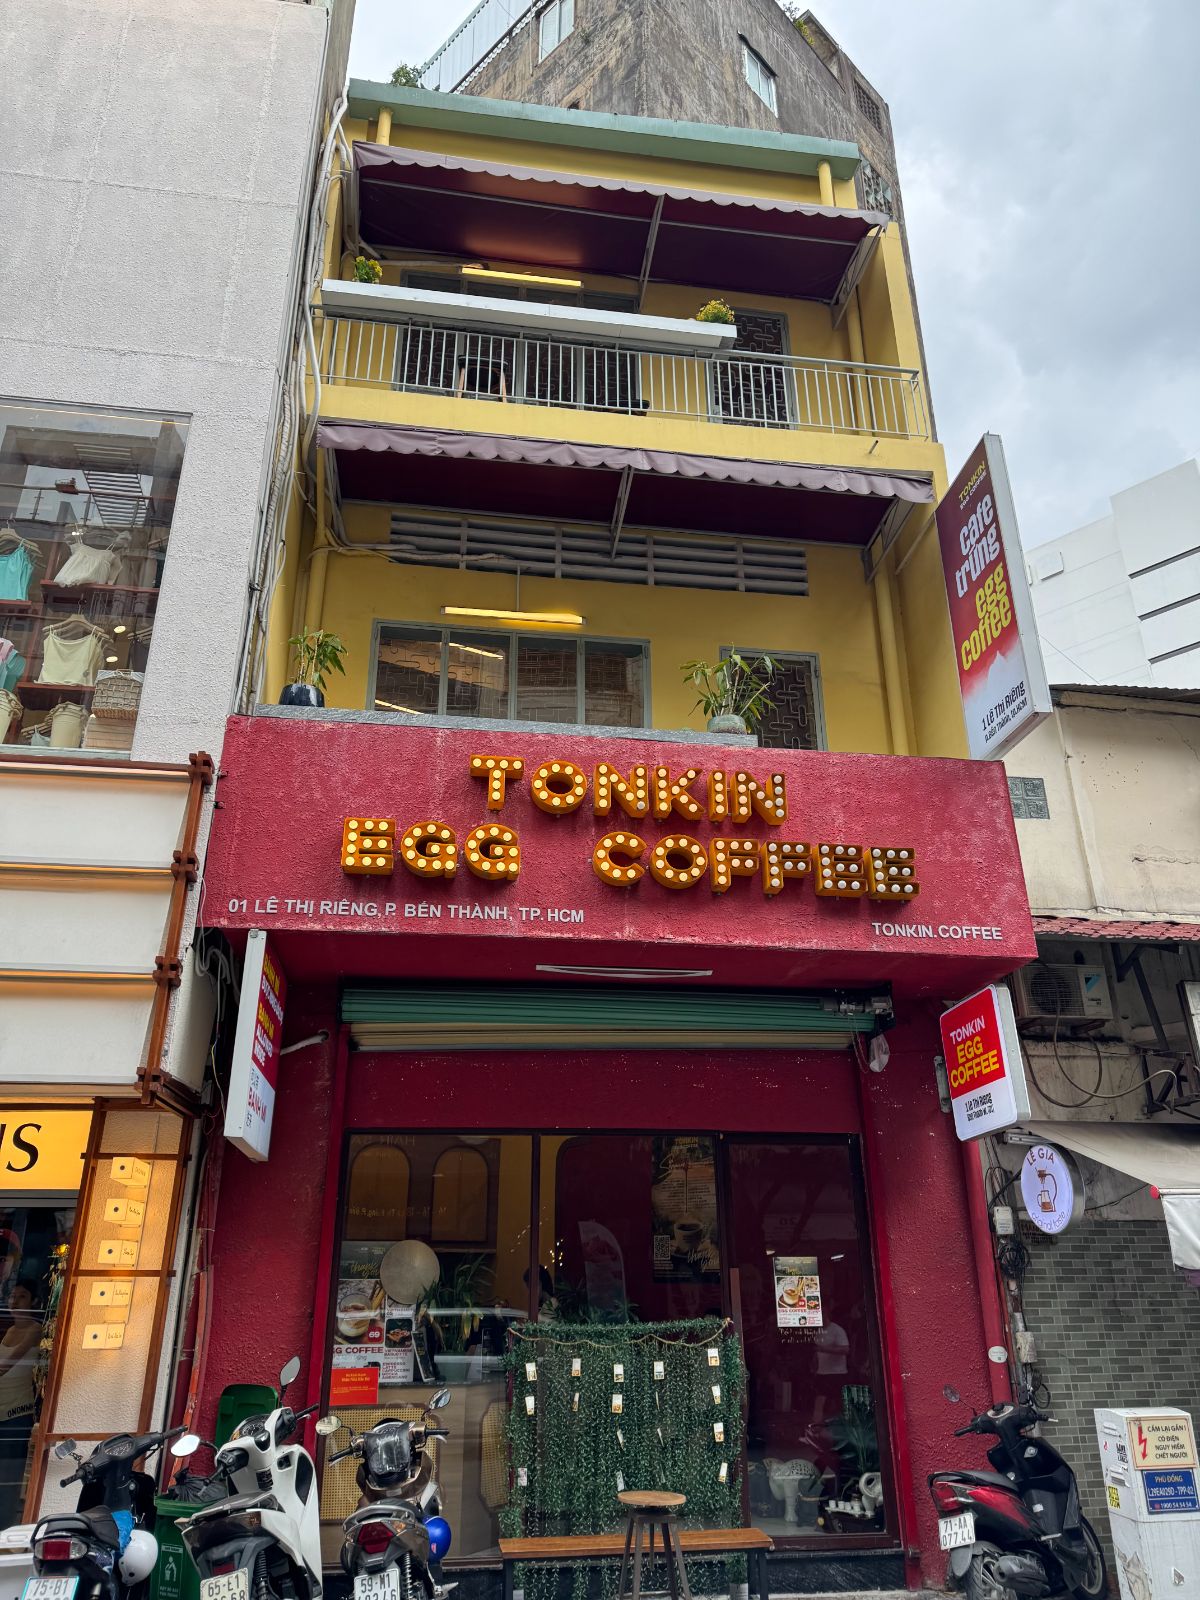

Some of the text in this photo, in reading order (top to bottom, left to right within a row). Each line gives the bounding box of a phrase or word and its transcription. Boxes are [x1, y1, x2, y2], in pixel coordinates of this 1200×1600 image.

[958, 461, 986, 501] TONKIN
[960, 494, 993, 556] cafe
[975, 562, 1007, 619] egg
[961, 595, 1012, 671] coffee
[987, 707, 996, 727] Lê
[995, 695, 1006, 718] Thị
[1004, 679, 1026, 711] Riêng
[470, 754, 788, 825] TONKIN
[341, 817, 921, 900] EGG COFFEE
[228, 899, 247, 913] 01
[254, 896, 279, 914] LÊ
[284, 899, 314, 918] THỊ
[404, 900, 442, 918] BẾN
[448, 902, 513, 922] THÀNH,
[871, 922, 1003, 941] TONKIN.COFFEE
[950, 1015, 986, 1045] TONKIN
[956, 1036, 984, 1064] EGG
[950, 1049, 1000, 1088] COFFEE
[0, 1123, 42, 1172] S
[1027, 1148, 1055, 1166] LÊ GIA
[942, 1529, 973, 1547] 077.44
[944, 1516, 968, 1533] 71-AA
[33, 1579, 69, 1596] 75-B1
[208, 1576, 241, 1597] 65-E1
